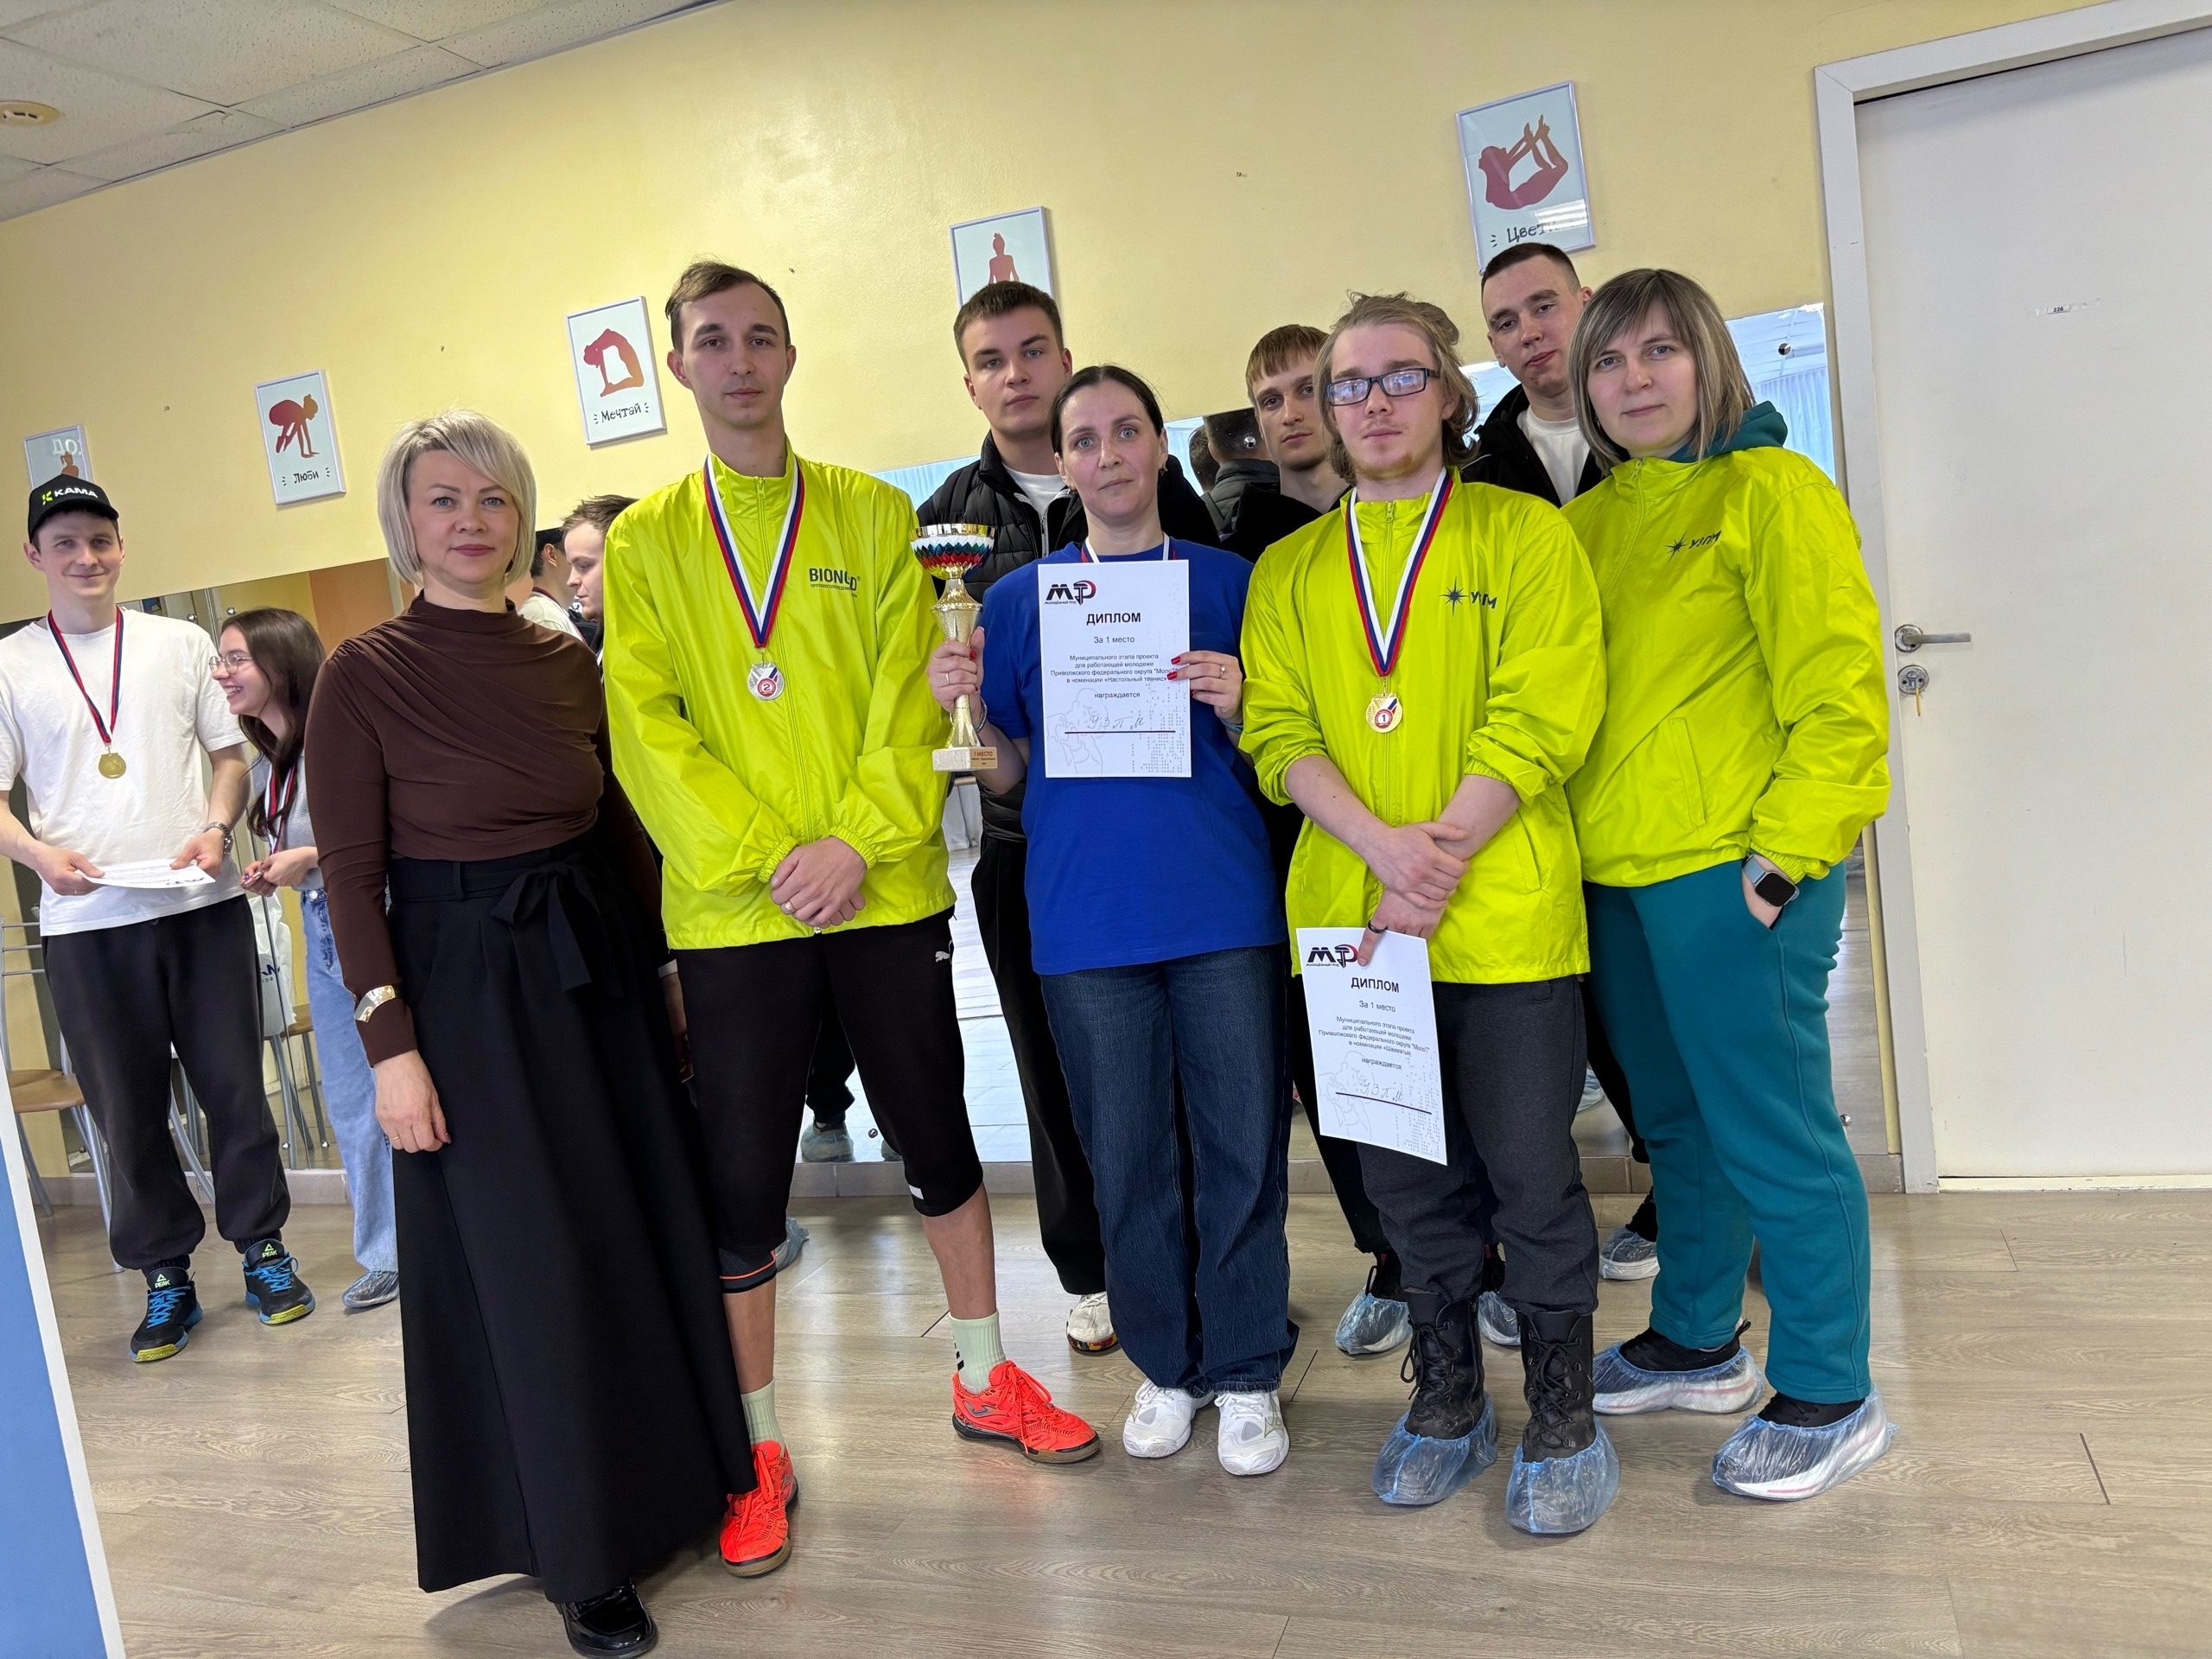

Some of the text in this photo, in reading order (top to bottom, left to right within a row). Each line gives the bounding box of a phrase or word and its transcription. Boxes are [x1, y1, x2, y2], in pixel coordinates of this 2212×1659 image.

[1506, 221, 1559, 243] Цвет
[601, 403, 642, 423] Мечтай
[294, 470, 319, 484] Люби
[54, 486, 99, 499] KAMA
[1086, 613, 1141, 626] ДИПЛОМ
[763, 683, 771, 691] 2
[1382, 714, 1386, 722] 1
[1351, 977, 1400, 993] ДИПЛОМ
[1359, 1000, 1369, 1008] За
[1336, 1016, 1382, 1027] Муниципального
[1353, 1026, 1387, 1035] работающей
[1319, 1029, 1357, 1039] Приволжского
[1358, 1033, 1395, 1045] федерального
[1353, 1041, 1382, 1050] номинации
[1362, 1058, 1402, 1070] награждается
[262, 1249, 278, 1258] PEAK
[155, 1280, 170, 1288] PEAK
